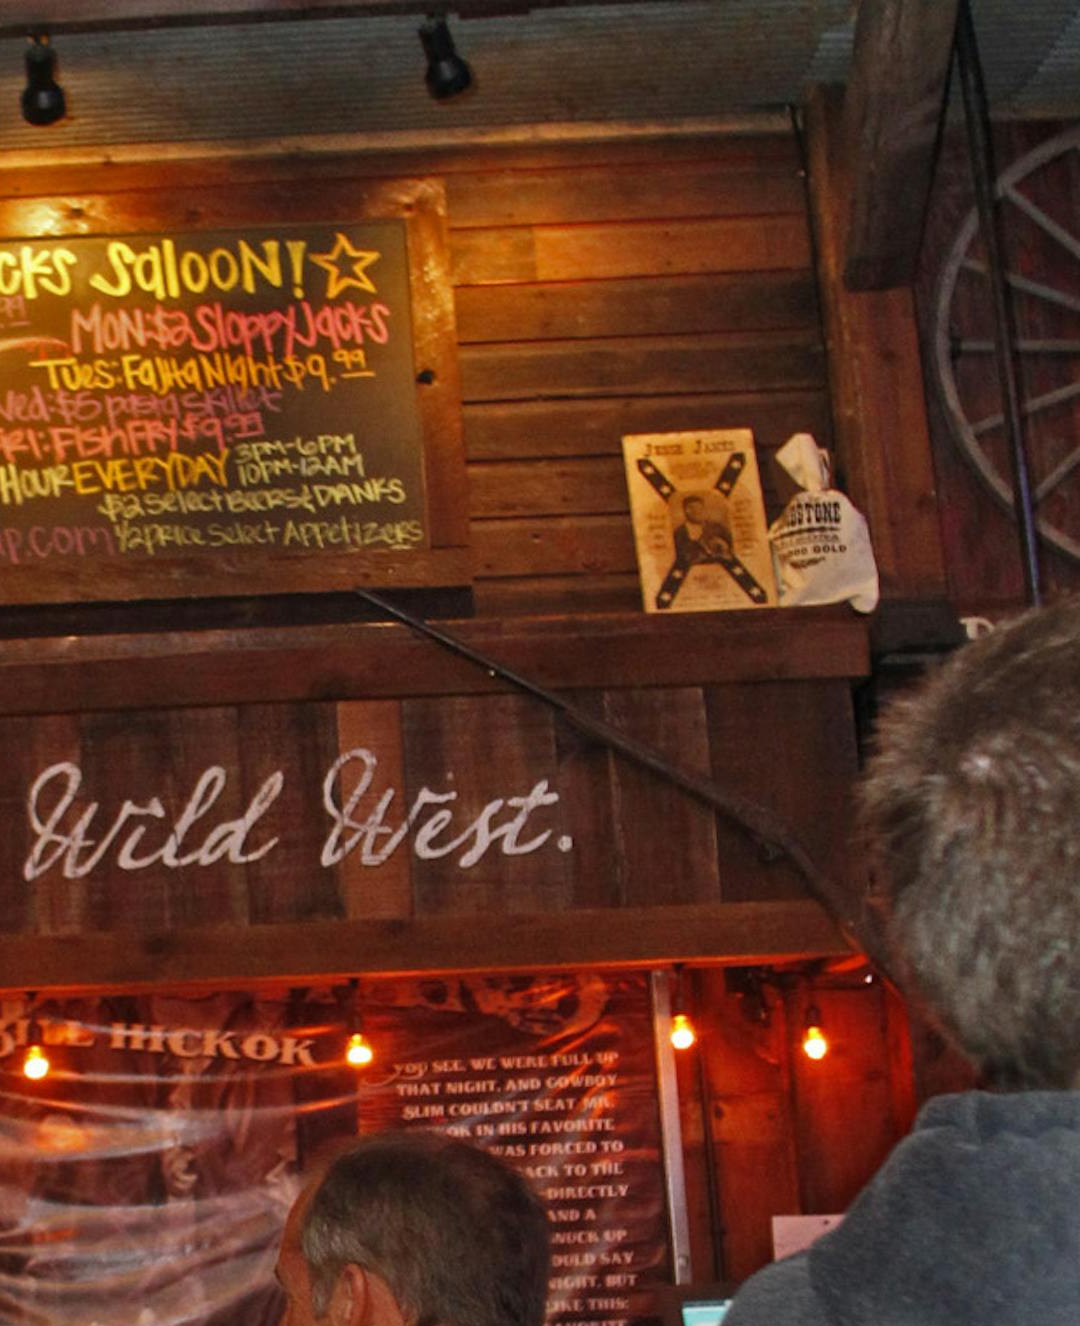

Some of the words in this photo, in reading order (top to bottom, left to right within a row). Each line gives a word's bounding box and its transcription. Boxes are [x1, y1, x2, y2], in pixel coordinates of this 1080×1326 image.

[23, 761, 286, 883] Wild
[320, 748, 573, 868] West.
[110, 1021, 320, 1068] HICKOK
[470, 1057, 498, 1071] WE
[499, 1055, 548, 1069] WERE
[550, 1053, 593, 1067] FULL
[396, 1081, 442, 1097] THAT
[505, 1077, 542, 1092] AND
[401, 1104, 445, 1121] SLIM
[533, 1097, 576, 1112] SEAT
[476, 1123, 495, 1137] IN
[497, 1122, 528, 1136] HIS
[530, 1118, 616, 1135] FAVORITE
[530, 1142, 597, 1157] FORCED
[600, 1140, 624, 1153] TO
[524, 1165, 559, 1179] ACK
[563, 1163, 588, 1177] TO
[590, 1161, 625, 1176] THE
[546, 1184, 630, 1199] DIRECTLY
[584, 1208, 597, 1221] A
[602, 1229, 628, 1242] UP
[550, 1252, 598, 1267] OULD
[600, 1250, 634, 1265] SAY
[605, 1273, 638, 1287] BUT
